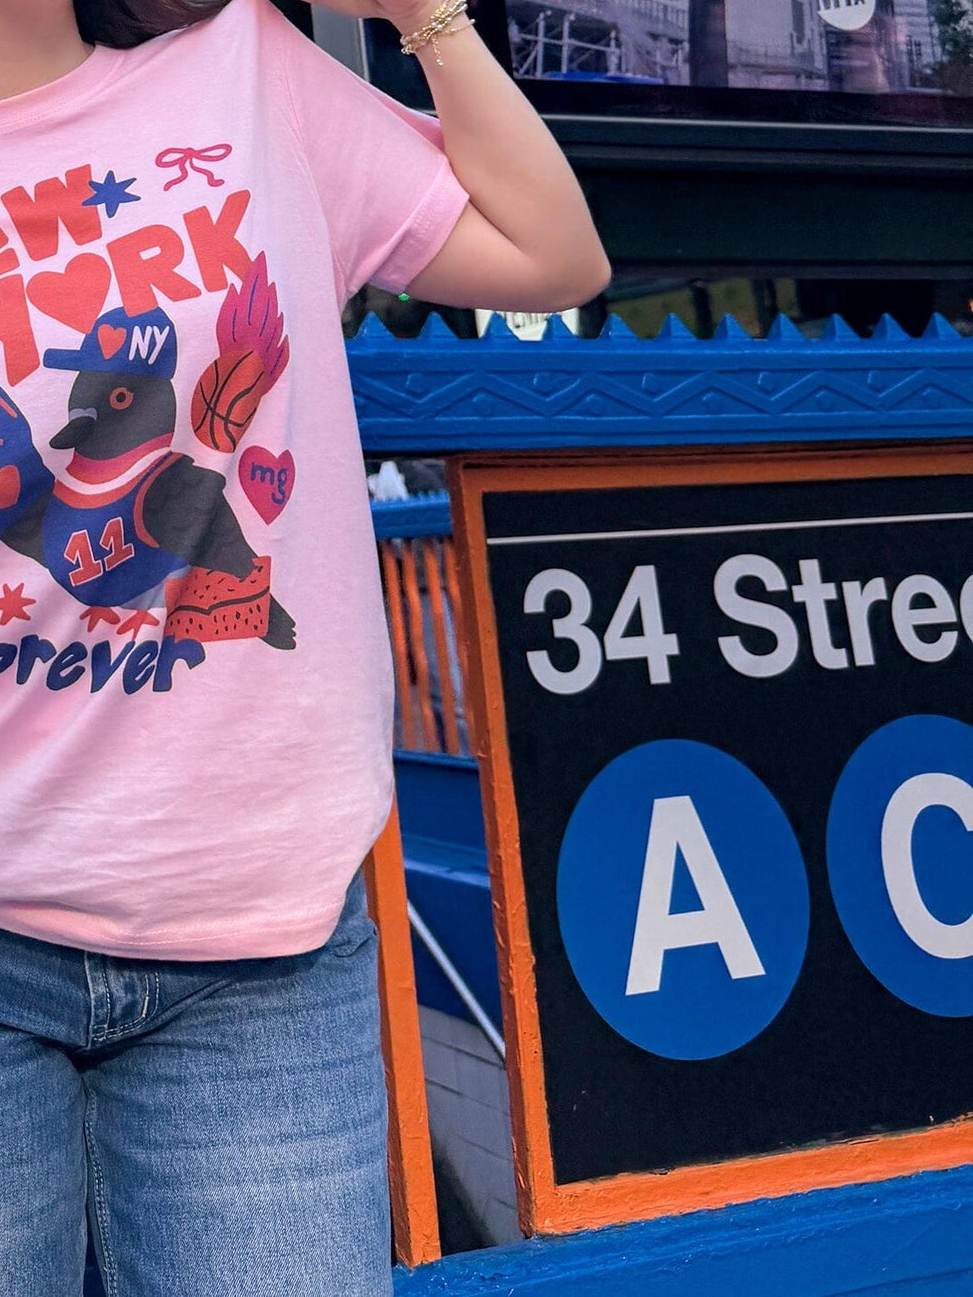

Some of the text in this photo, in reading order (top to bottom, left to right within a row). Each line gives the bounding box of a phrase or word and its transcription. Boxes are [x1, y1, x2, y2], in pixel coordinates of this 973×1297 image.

[129, 325, 170, 365] NY
[63, 516, 136, 587] 11
[523, 552, 973, 695] 34 Stre
[625, 772, 973, 997] A C
